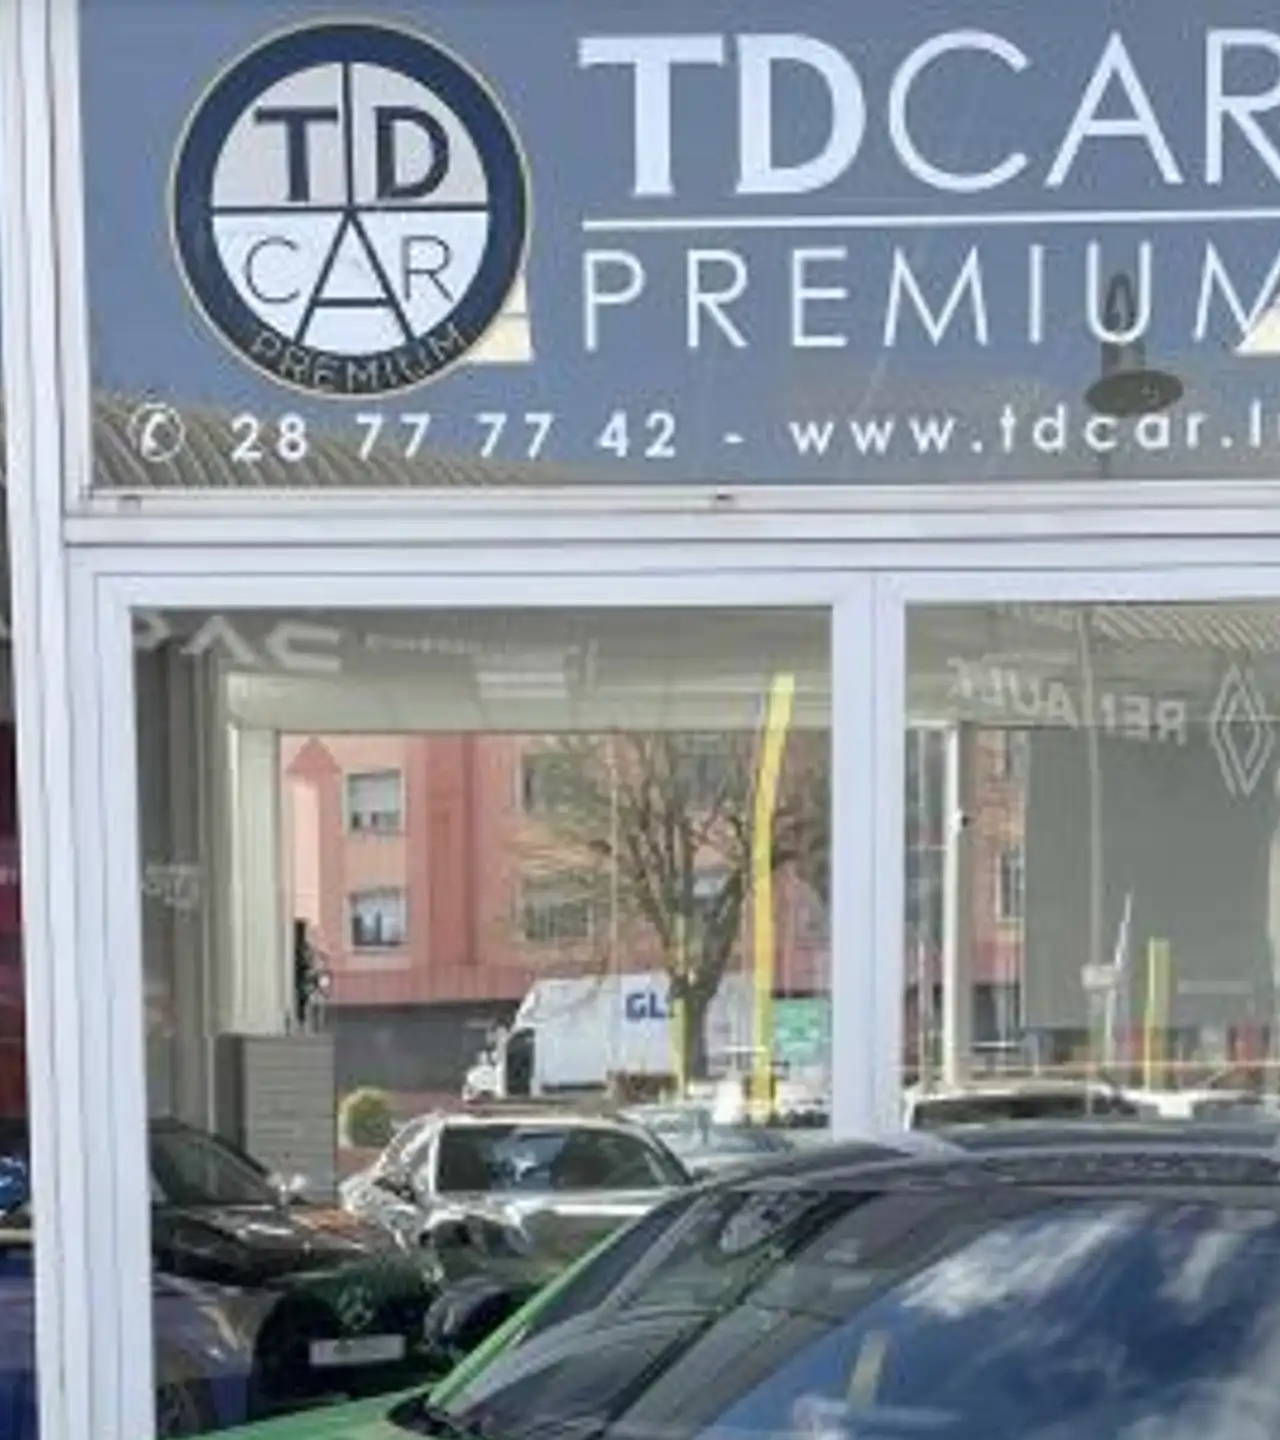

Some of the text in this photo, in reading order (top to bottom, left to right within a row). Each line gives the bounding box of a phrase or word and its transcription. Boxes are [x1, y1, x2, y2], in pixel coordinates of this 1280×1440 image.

[254, 104, 451, 202] TD
[243, 210, 455, 345] CAR
[250, 320, 467, 394] PREMIUM
[229, 411, 309, 461] 28
[356, 411, 432, 459] 77
[477, 411, 554, 459] 77
[596, 409, 677, 458] 42
[624, 992, 674, 1022] GL
